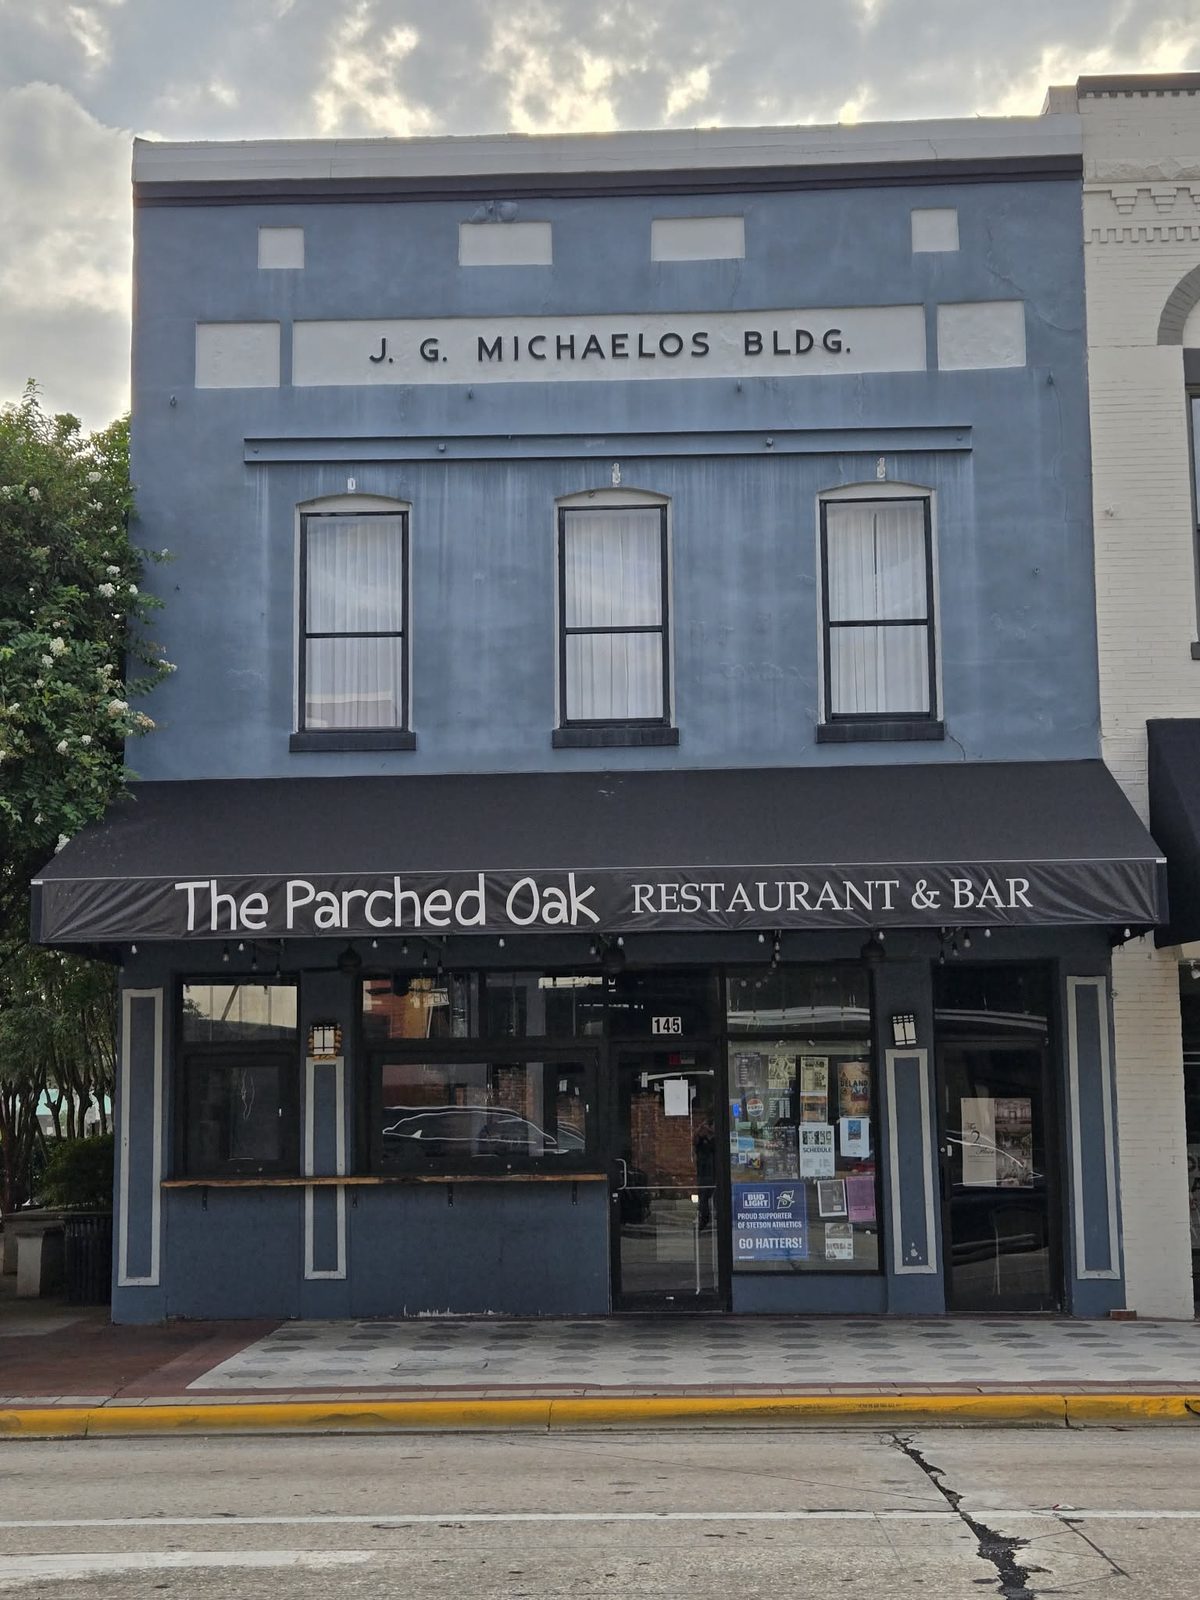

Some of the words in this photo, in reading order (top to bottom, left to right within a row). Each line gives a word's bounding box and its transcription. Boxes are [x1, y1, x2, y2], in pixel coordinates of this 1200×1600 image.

[369, 338, 394, 364] J.
[419, 337, 448, 363] G.
[477, 331, 711, 362] MICHAELOS
[744, 328, 852, 356] BLDG.
[174, 879, 269, 931] The
[286, 873, 486, 929] Parched
[505, 872, 600, 926] Oak
[631, 880, 899, 914] RESTAURANT
[910, 880, 941, 910] &
[951, 877, 1034, 909] BAR
[653, 1017, 680, 1034] 145
[737, 1212, 758, 1220] PROUD
[758, 1212, 792, 1220] SUPPORTER
[746, 1221, 771, 1229] STETSON
[772, 1221, 802, 1229] ATHLETICS
[738, 1238, 753, 1249] GO
[755, 1237, 803, 1249] HATTERS!
